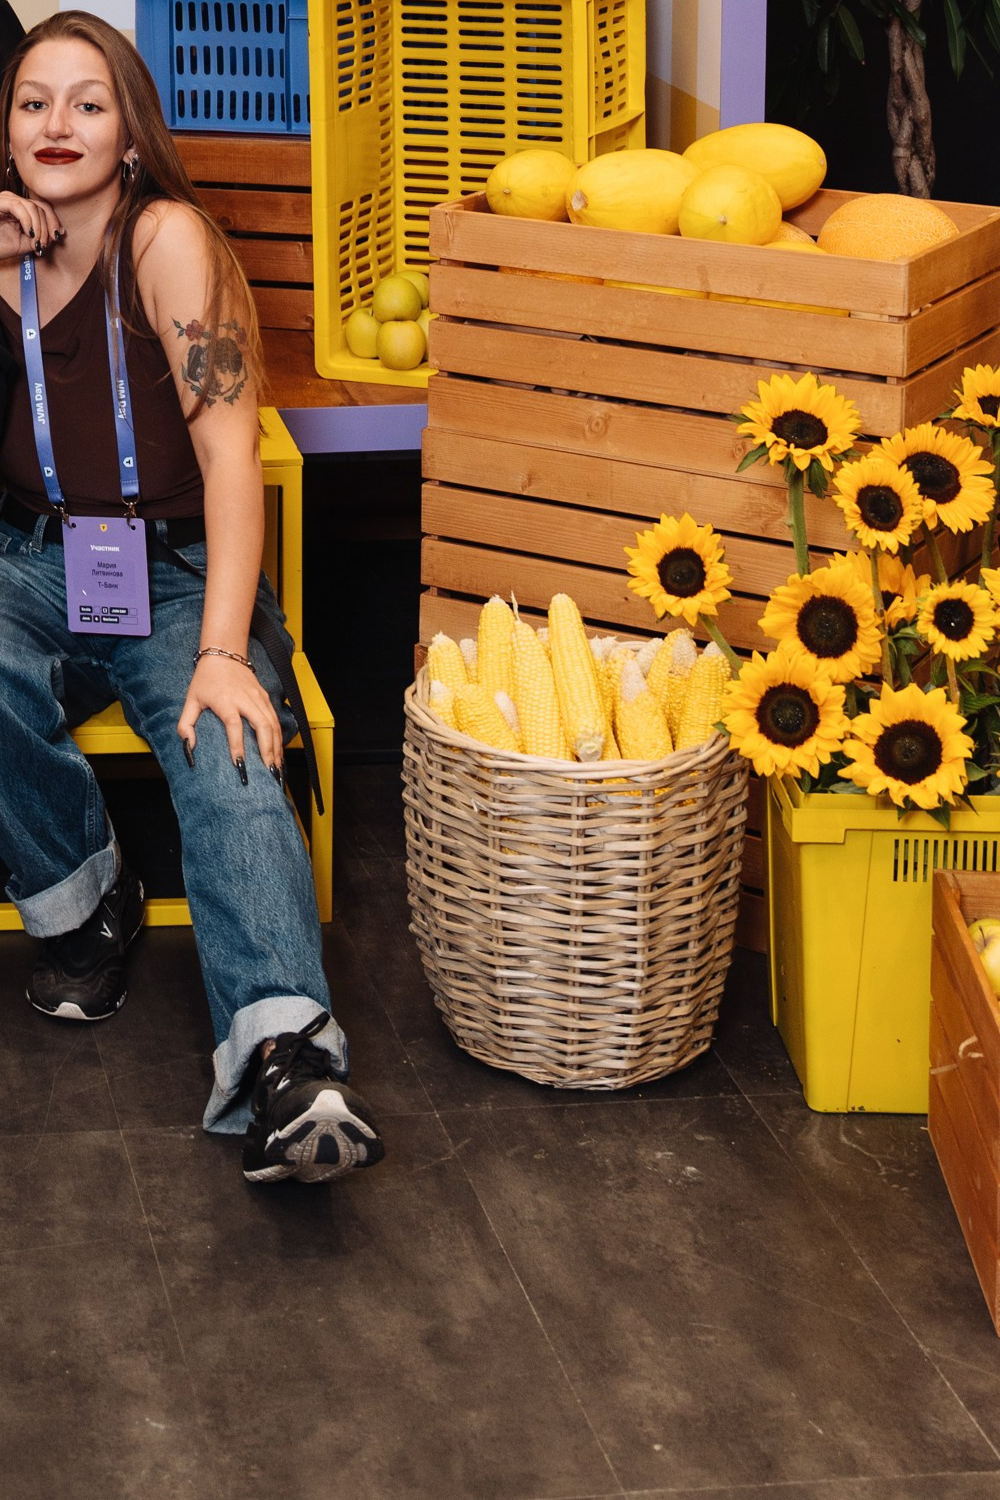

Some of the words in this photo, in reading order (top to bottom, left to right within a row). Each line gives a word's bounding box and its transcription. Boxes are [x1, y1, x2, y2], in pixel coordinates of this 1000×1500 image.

[23, 254, 32, 281] Scala
[34, 382, 43, 402] Day
[36, 402, 46, 425] JVM
[90, 544, 120, 552] Участник
[97, 561, 117, 570] Мария
[97, 581, 119, 589] Т-Банк
